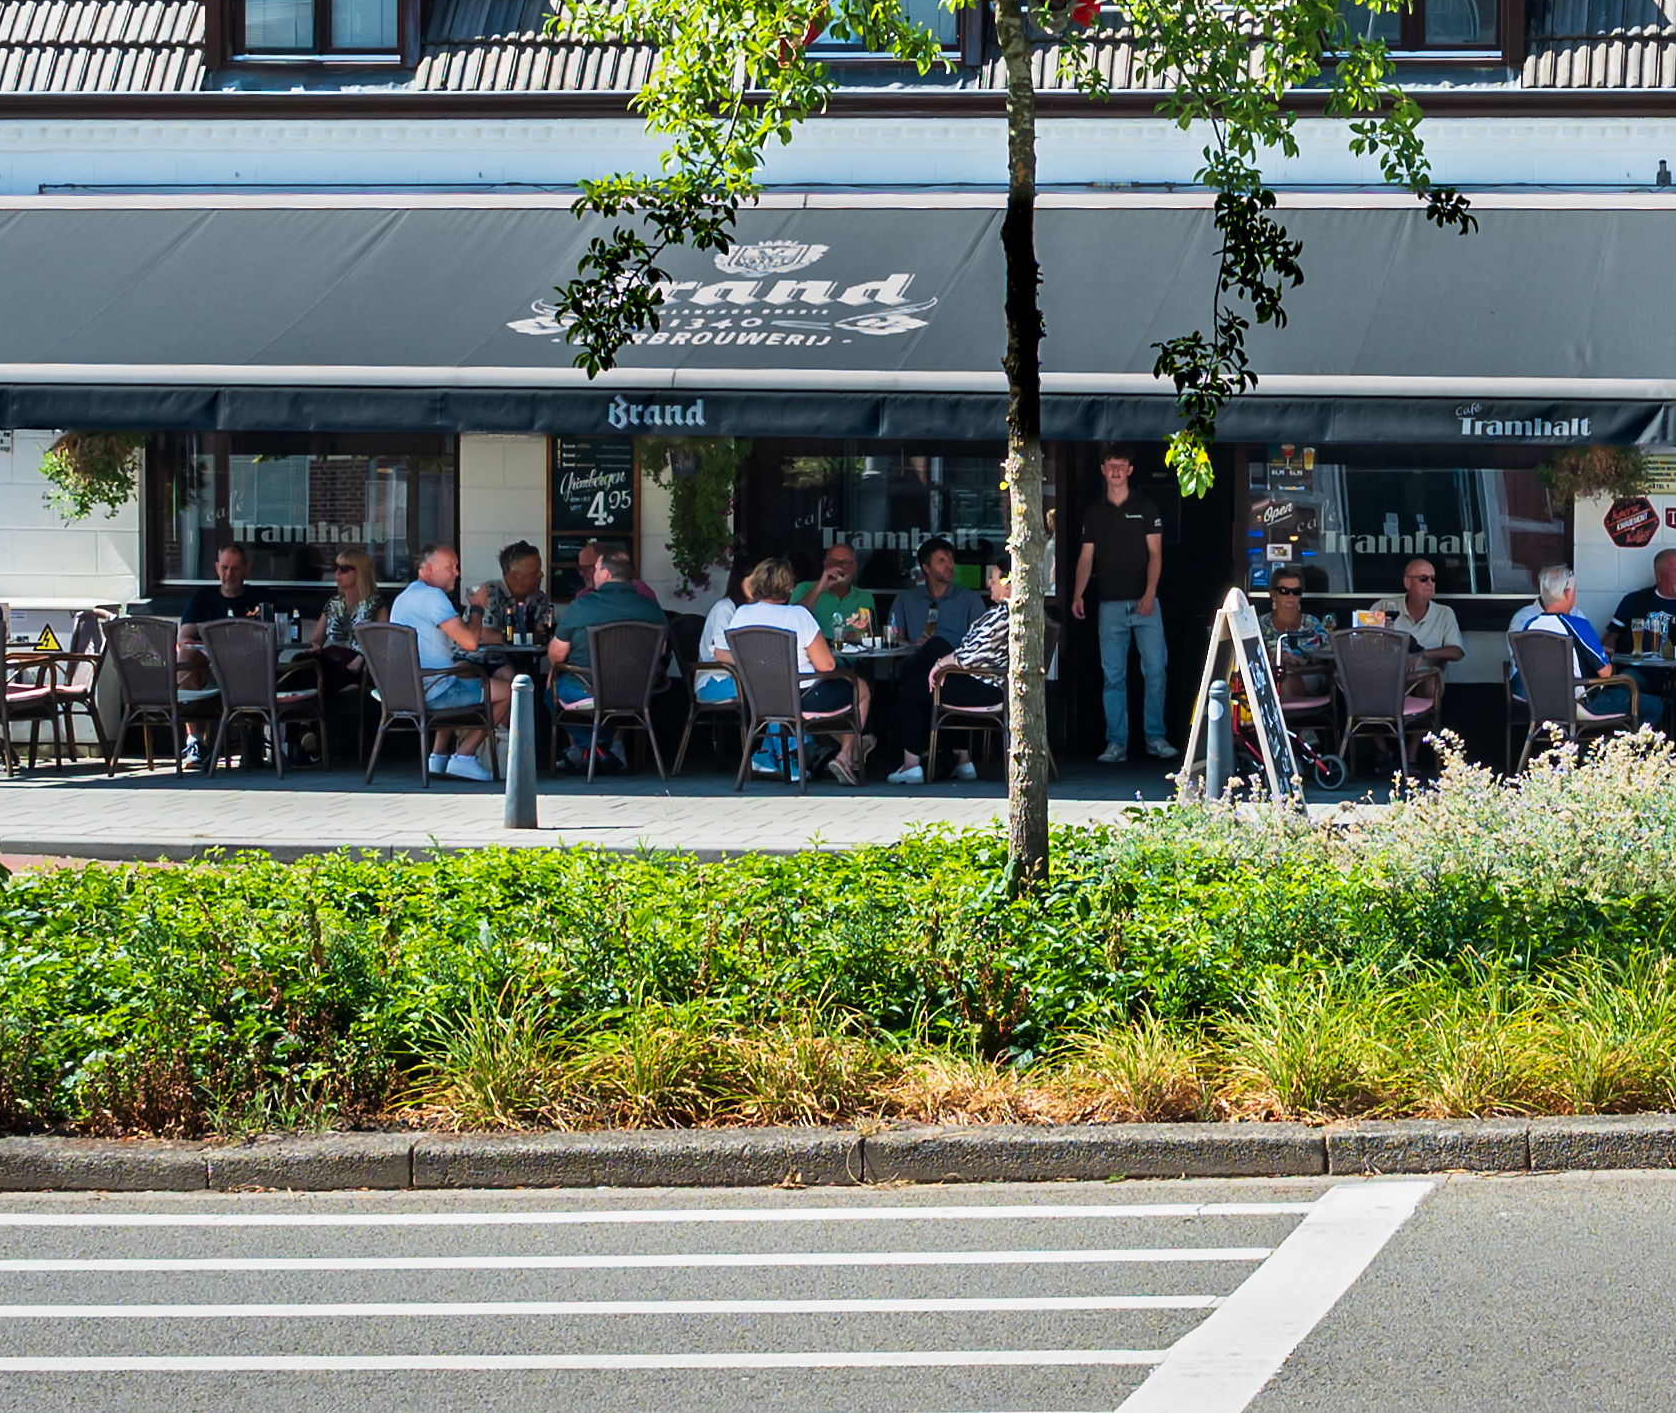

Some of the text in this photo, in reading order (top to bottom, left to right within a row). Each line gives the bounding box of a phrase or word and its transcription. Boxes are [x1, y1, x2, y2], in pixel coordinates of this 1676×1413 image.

[667, 317, 765, 329] 1340
[607, 394, 706, 430] Brand
[1458, 417, 1592, 436] Tramhalt
[1263, 502, 1294, 523] Open
[1321, 530, 1489, 554] Tramhalt
